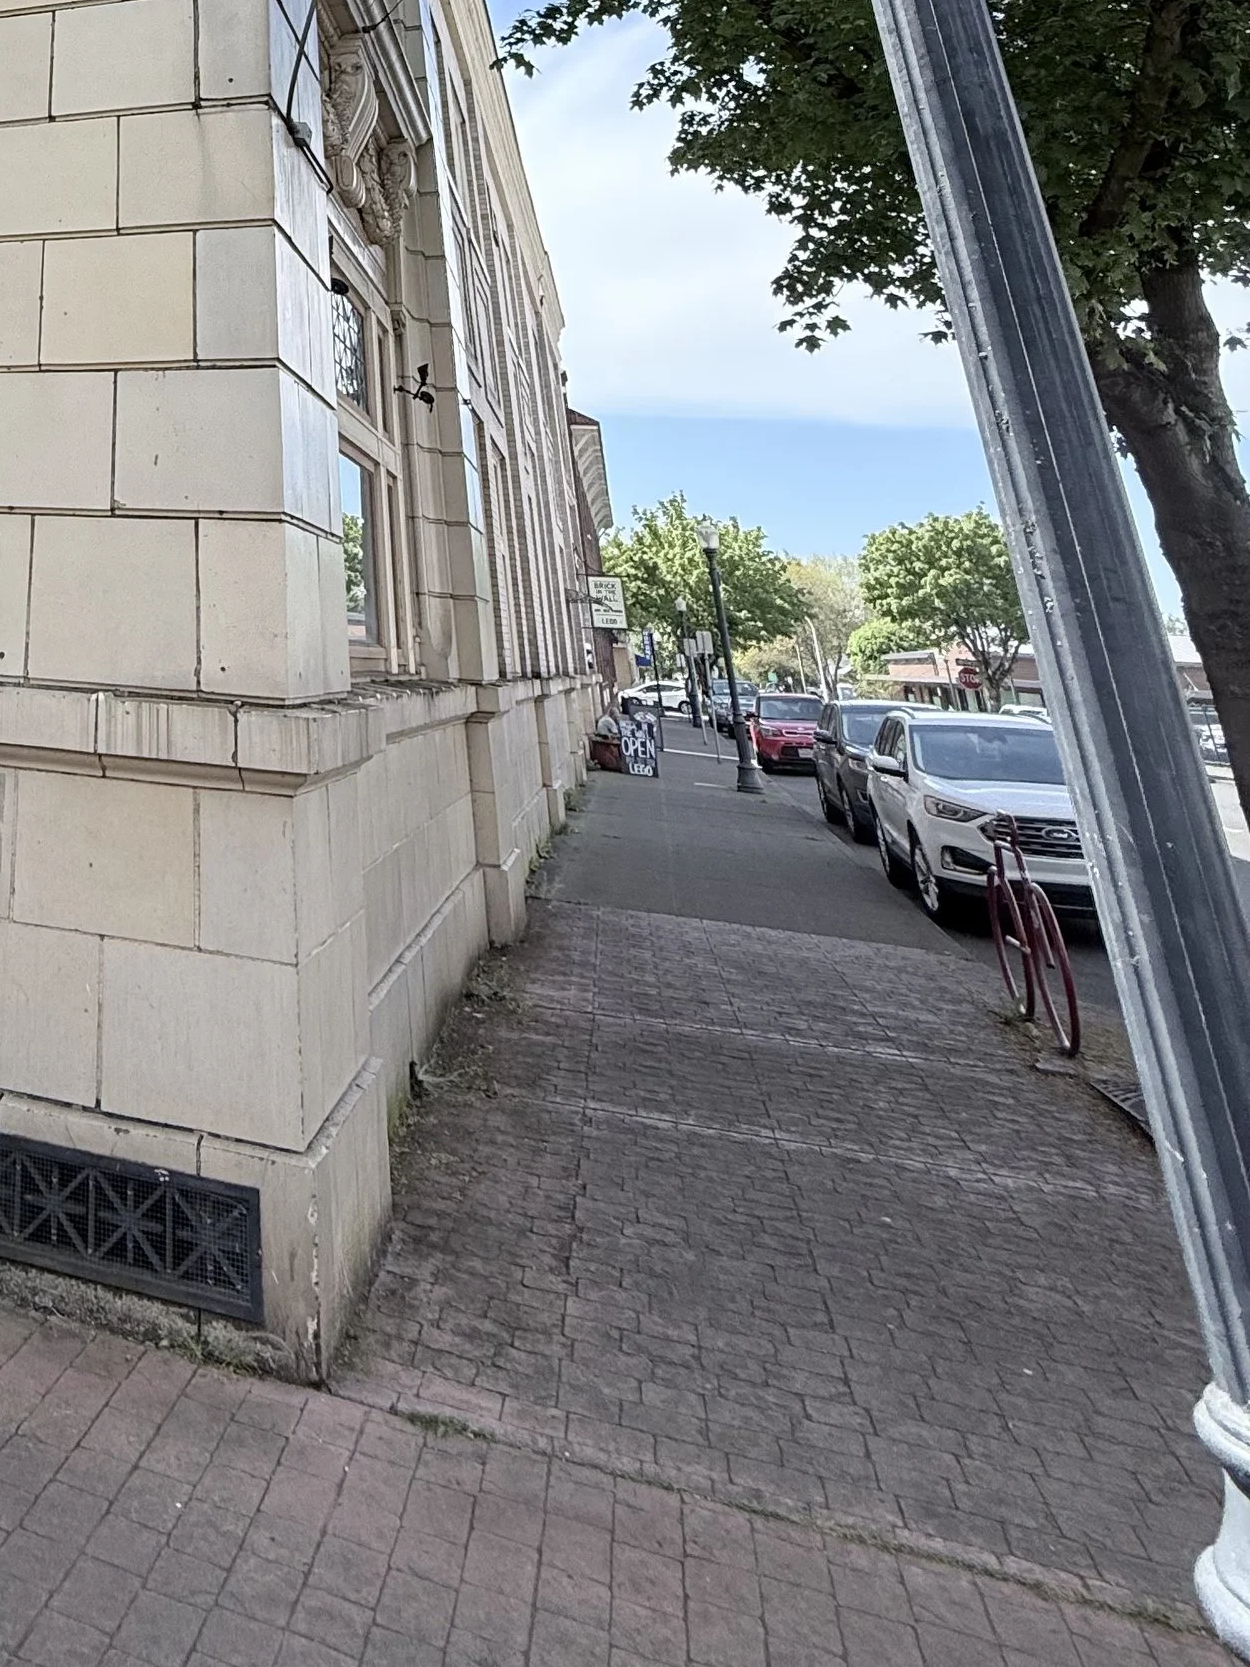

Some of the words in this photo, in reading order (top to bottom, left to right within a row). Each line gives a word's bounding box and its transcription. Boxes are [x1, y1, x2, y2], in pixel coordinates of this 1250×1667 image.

[960, 673, 980, 684] STO
[621, 737, 656, 759] OPEN
[629, 763, 654, 777] LEGO
